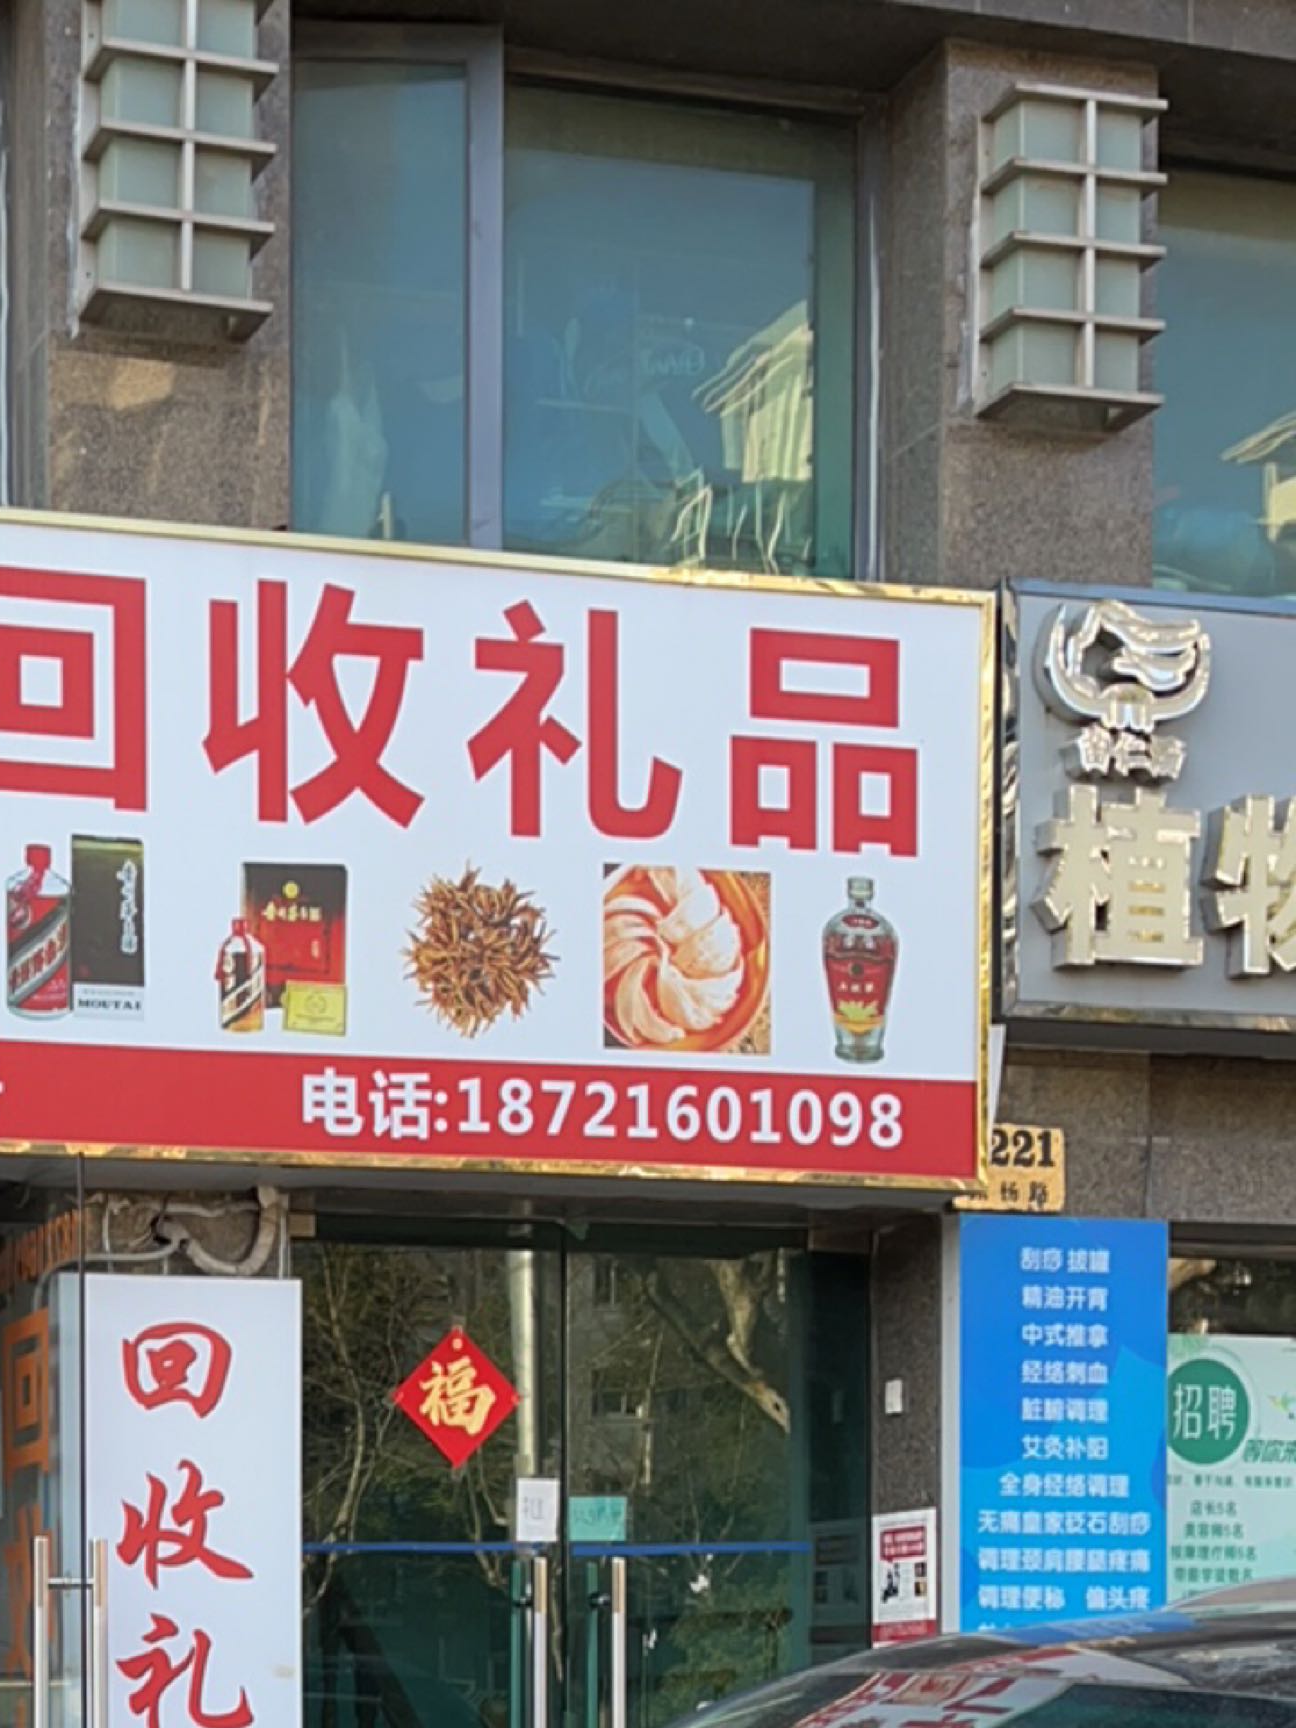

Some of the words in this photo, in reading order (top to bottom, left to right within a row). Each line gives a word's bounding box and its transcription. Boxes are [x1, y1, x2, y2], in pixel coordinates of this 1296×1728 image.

[302, 1067, 904, 1148] 电话:18721601098
[990, 1129, 1056, 1167] 221
[1022, 1324, 1109, 1348] 中式推拿
[419, 1355, 497, 1437] 福
[1173, 1383, 1237, 1440] 招聘
